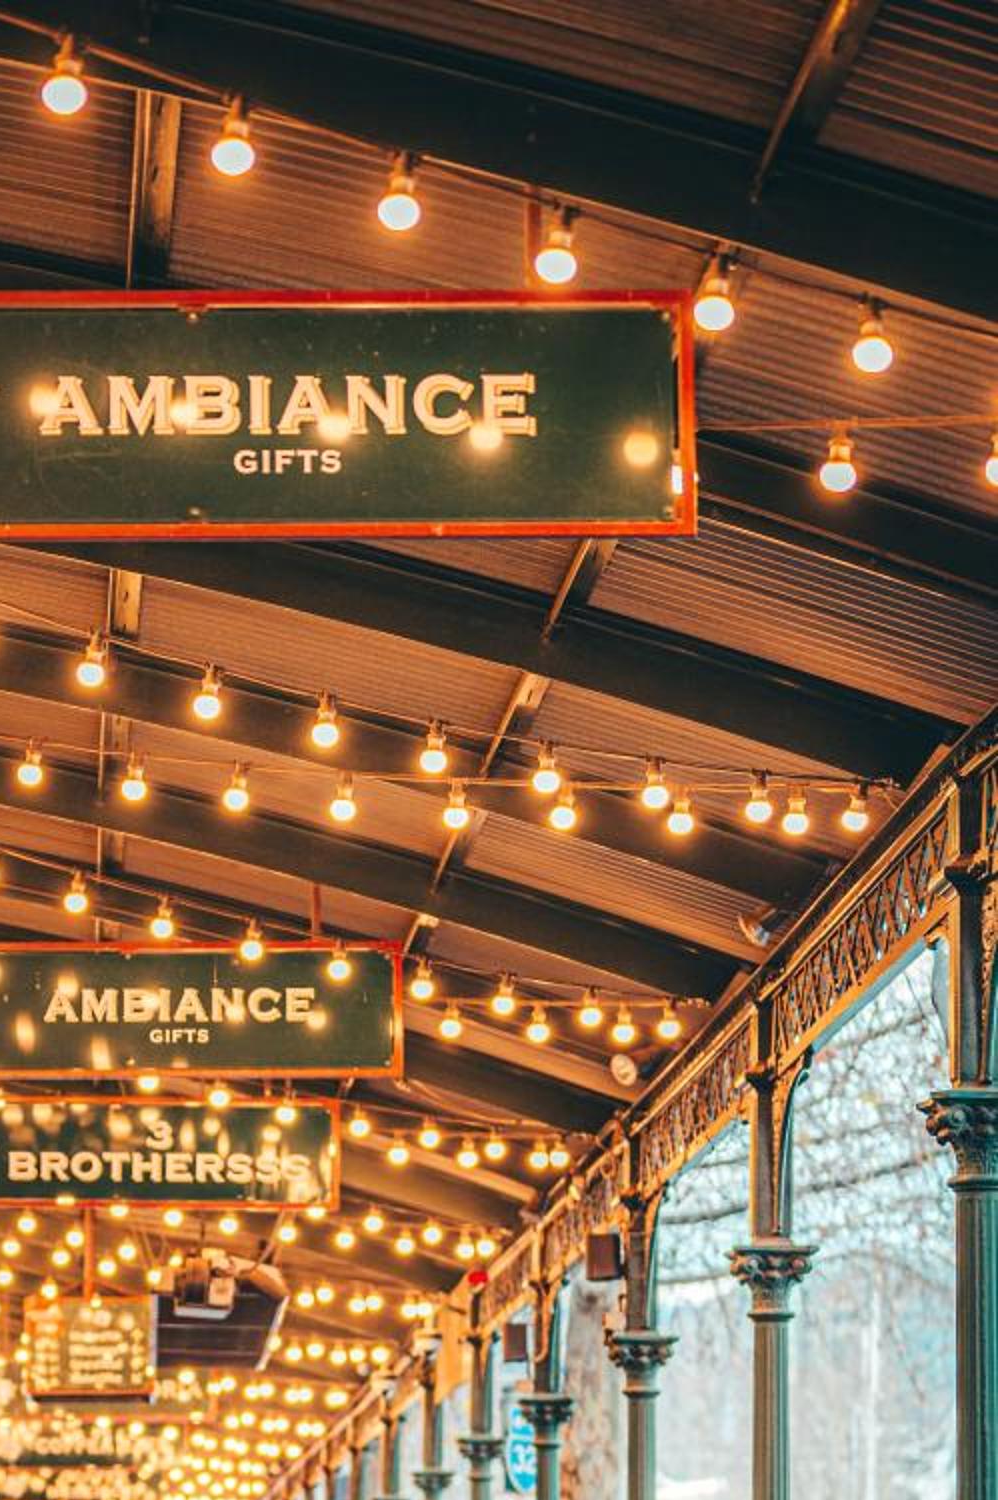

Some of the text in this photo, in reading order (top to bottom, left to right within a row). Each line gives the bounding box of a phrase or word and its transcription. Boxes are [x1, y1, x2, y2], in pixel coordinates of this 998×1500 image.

[38, 372, 538, 438] AMBIANCE
[232, 448, 343, 475] GIFTS
[43, 986, 316, 1024] AMBIANCE
[149, 1028, 210, 1044] GIFTS
[144, 1119, 175, 1150] 3
